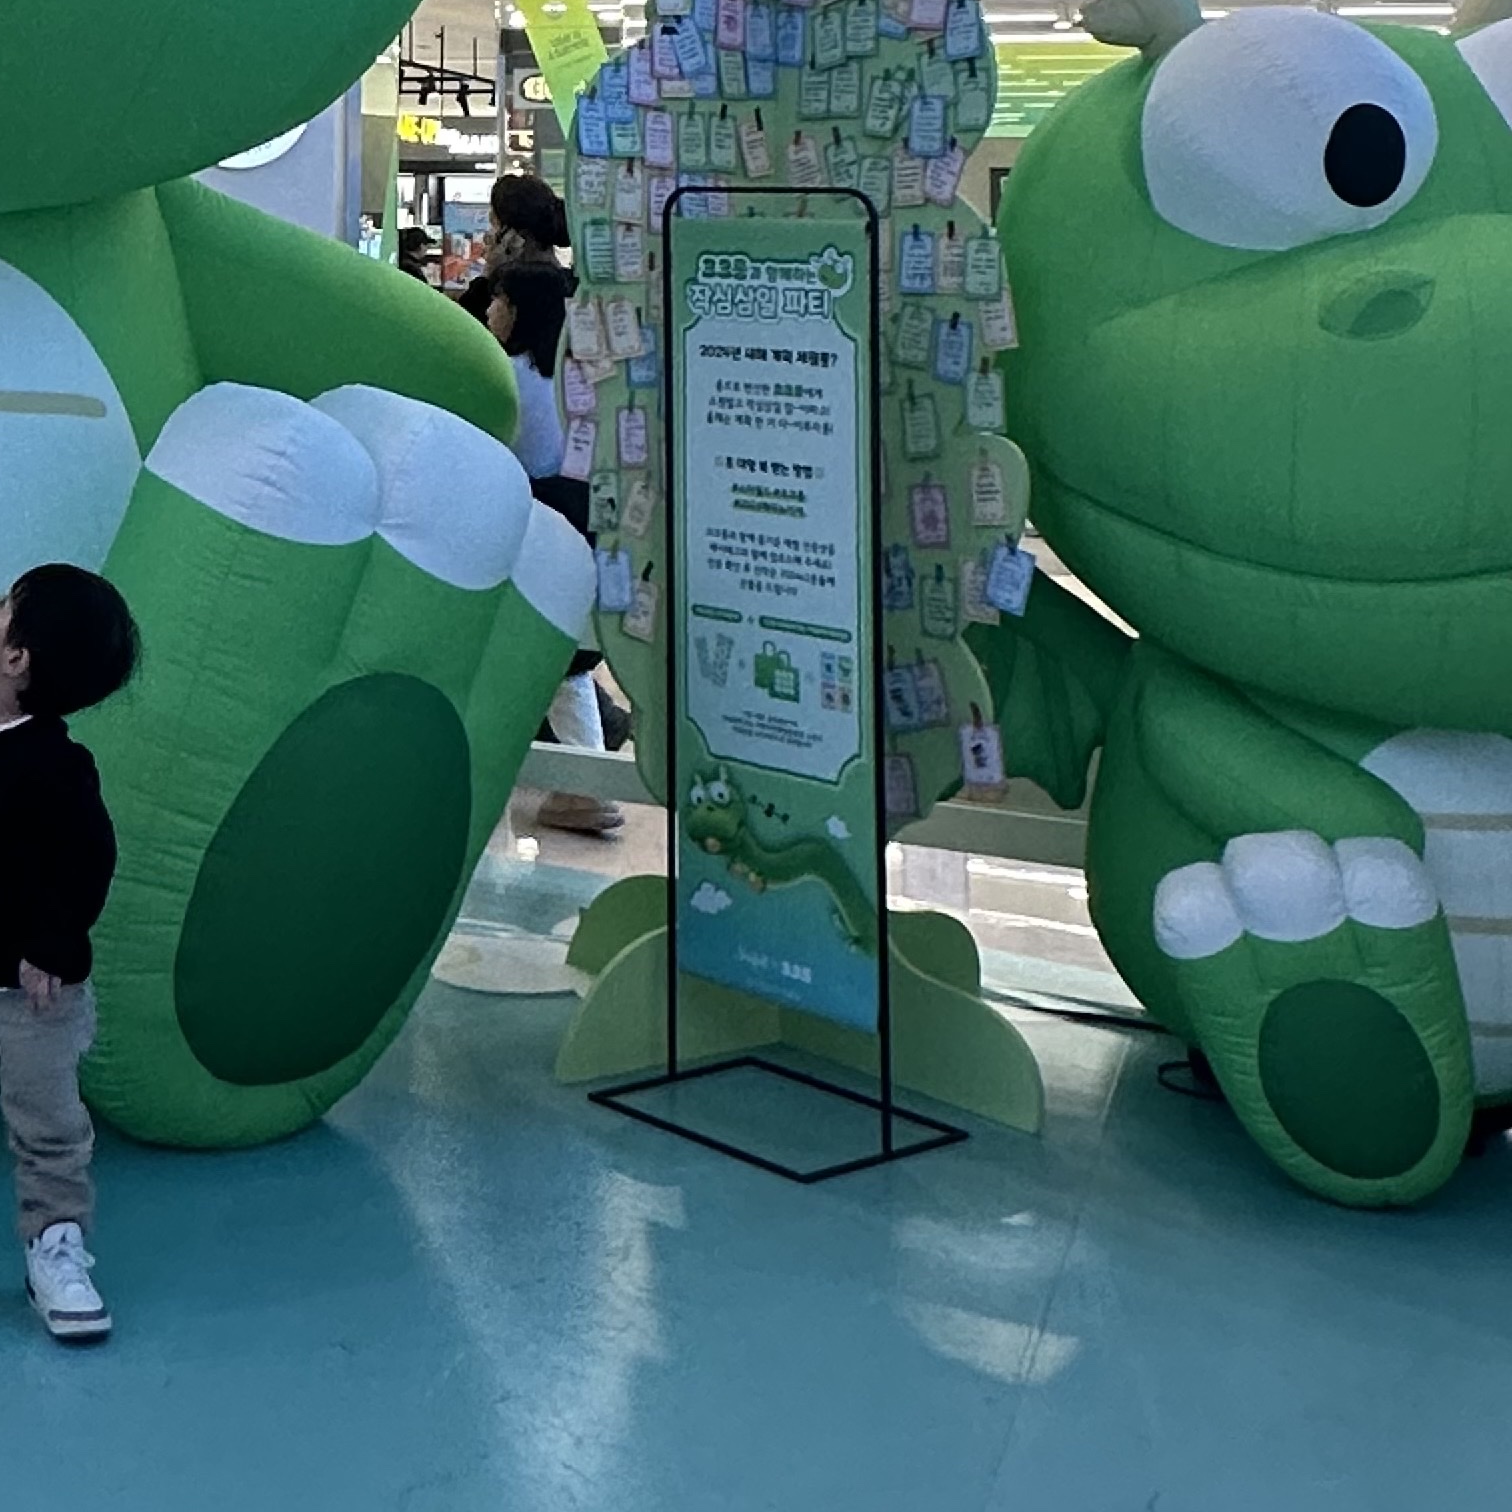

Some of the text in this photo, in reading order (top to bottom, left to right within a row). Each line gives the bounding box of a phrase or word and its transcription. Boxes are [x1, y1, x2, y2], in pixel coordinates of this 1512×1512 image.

[690, 284, 830, 318] 작심삼일 파티
[698, 344, 742, 362] 2024년
